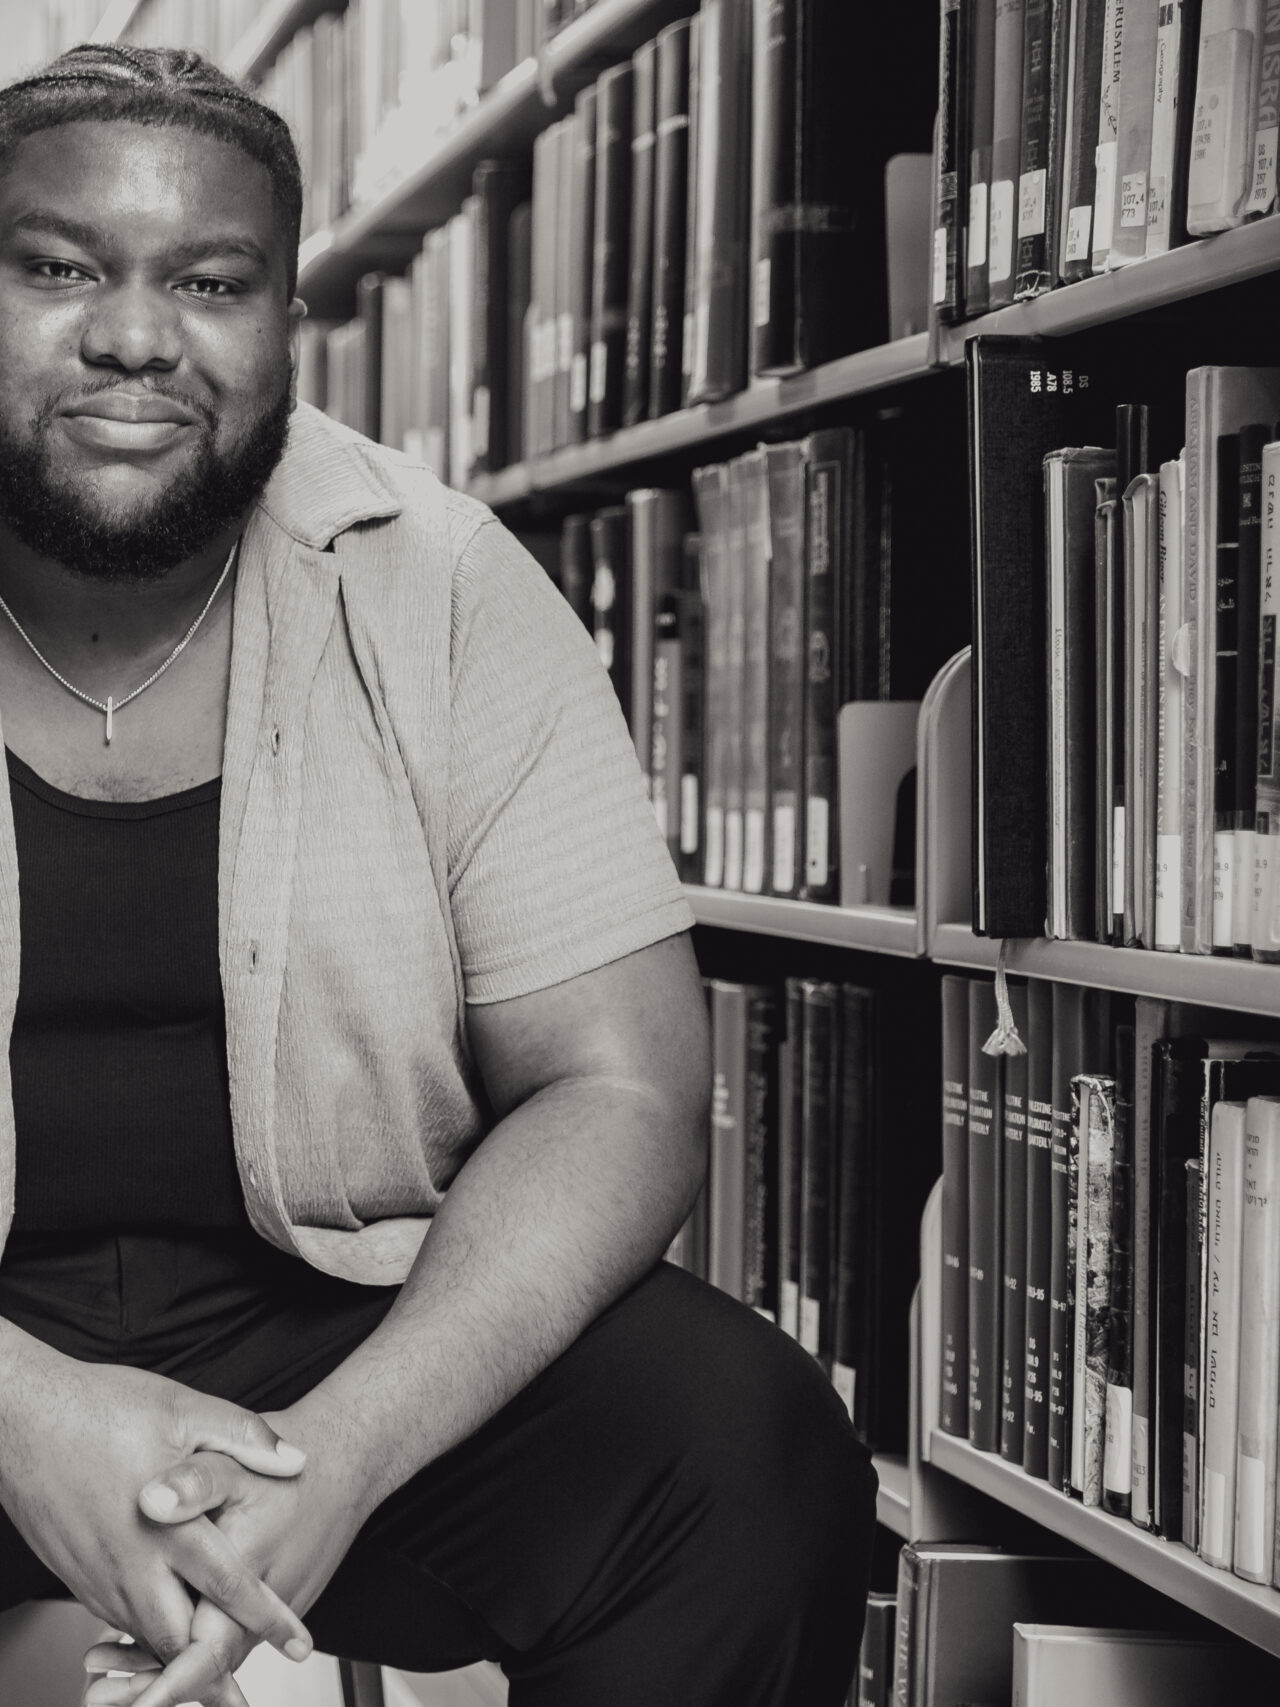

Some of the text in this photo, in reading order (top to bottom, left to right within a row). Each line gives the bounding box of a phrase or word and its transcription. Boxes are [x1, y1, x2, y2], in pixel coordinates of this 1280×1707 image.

[1258, 157, 1273, 170] 107.4
[1122, 181, 1132, 192] DS
[1122, 193, 1145, 206] 107.4
[1149, 200, 1165, 213] 107.4
[1030, 370, 1042, 393] 1985
[1062, 369, 1073, 394] 108.5
[1079, 375, 1089, 388] DS
[1188, 398, 1198, 601] ABRAHAM AND DAVID
[1265, 474, 1275, 602] מנשה הראל
[1028, 1099, 1052, 1116] ALESTINE
[1245, 1194, 1268, 1208] ירוש
